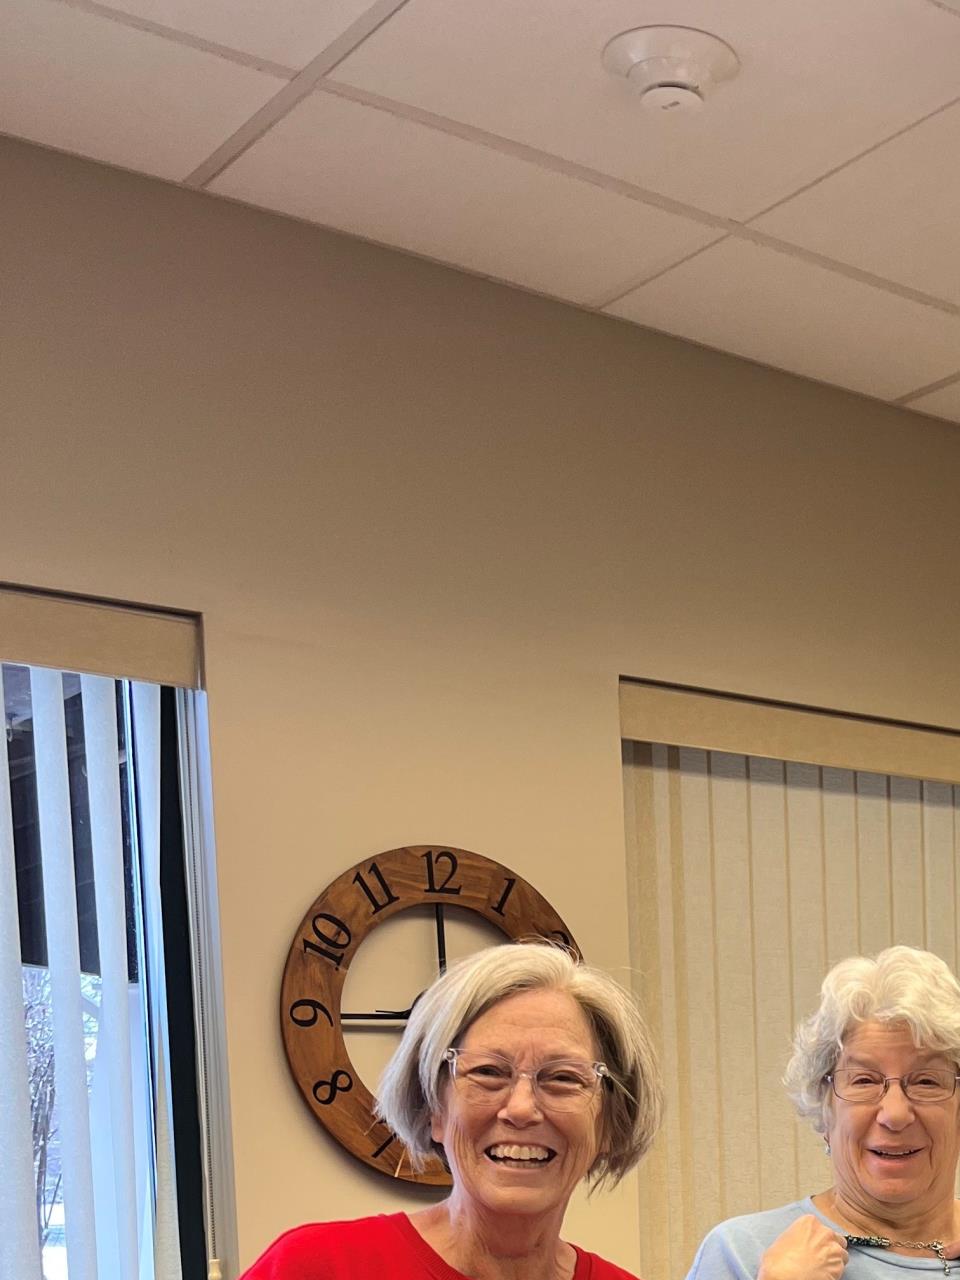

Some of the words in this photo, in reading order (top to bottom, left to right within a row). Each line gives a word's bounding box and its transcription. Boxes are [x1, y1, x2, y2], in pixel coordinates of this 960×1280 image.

[352, 862, 400, 916] 11
[420, 851, 463, 895] 12
[490, 877, 517, 918] 1
[302, 913, 352, 971] 10
[289, 998, 334, 1028] 9
[312, 1069, 354, 1106] 8
